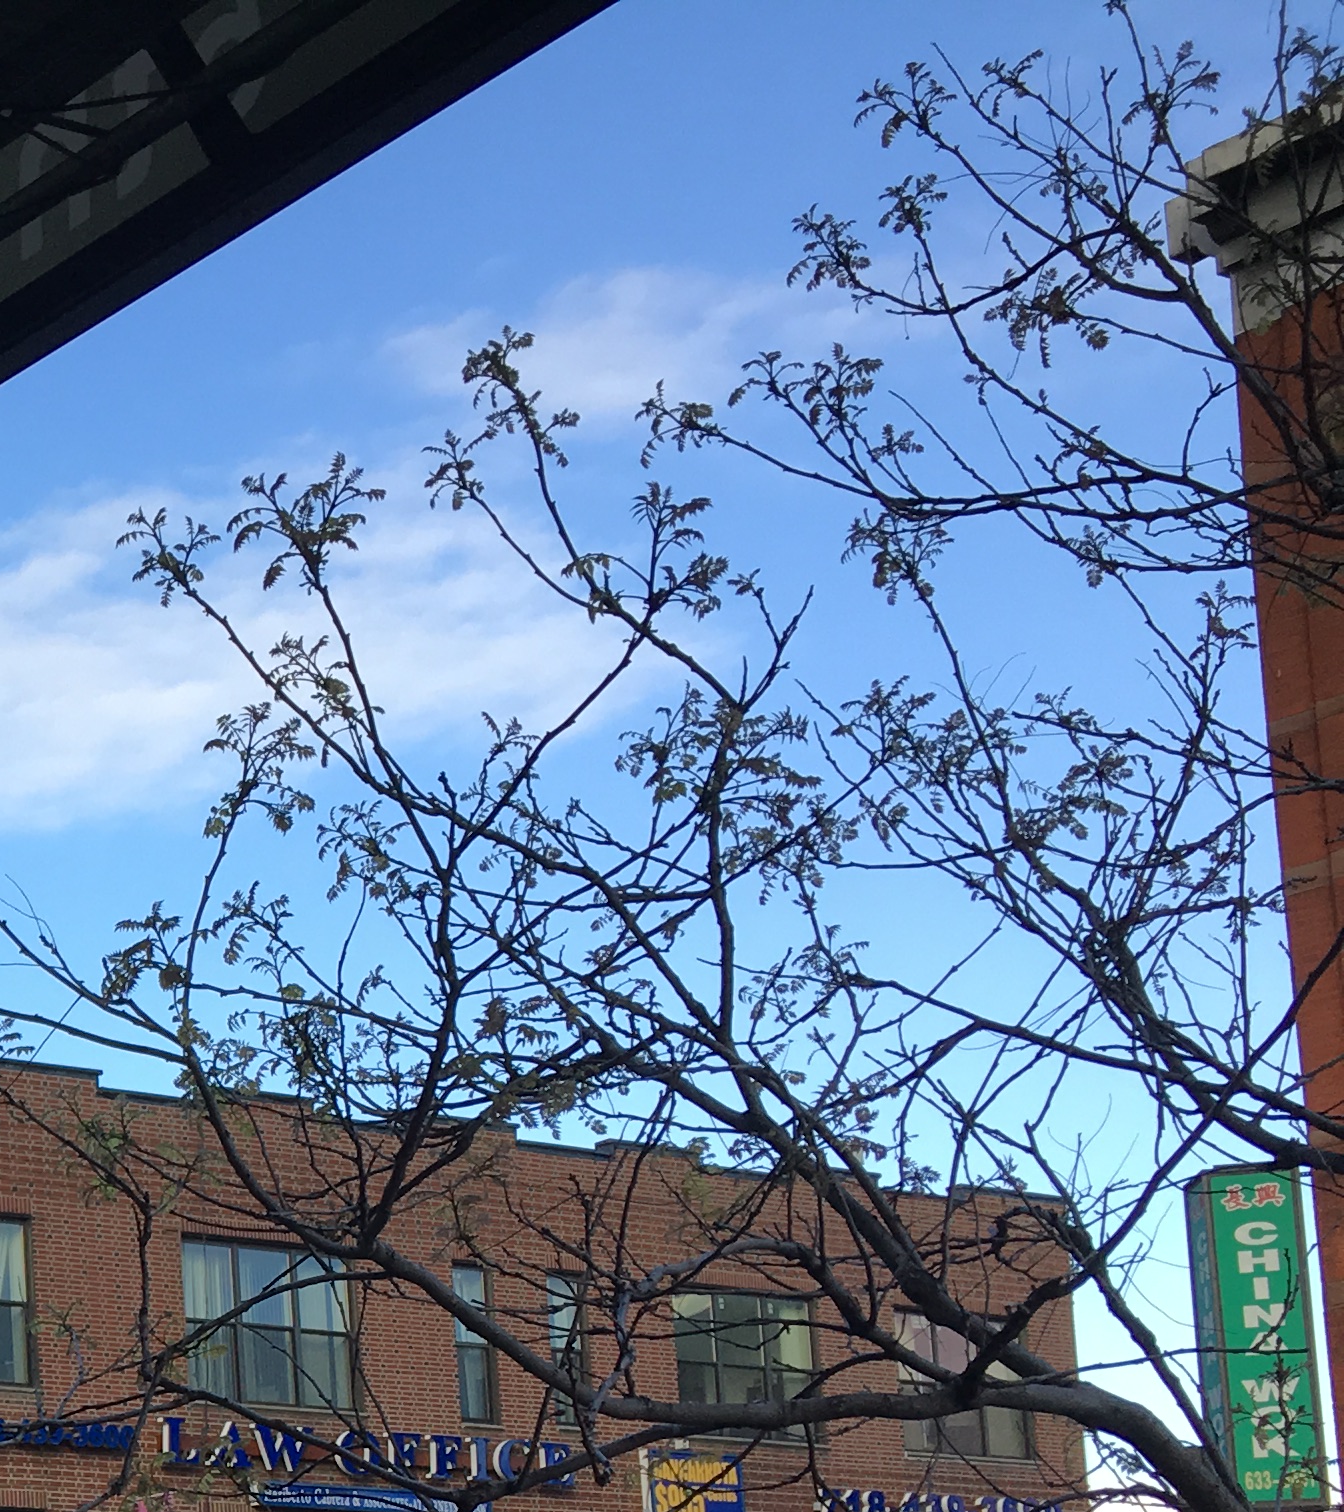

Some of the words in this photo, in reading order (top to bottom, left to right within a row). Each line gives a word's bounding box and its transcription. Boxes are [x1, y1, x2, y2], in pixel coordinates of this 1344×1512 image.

[1233, 1220, 1290, 1357] CHINA
[158, 1415, 313, 1472] LAW
[332, 1429, 575, 1487] OFFICE
